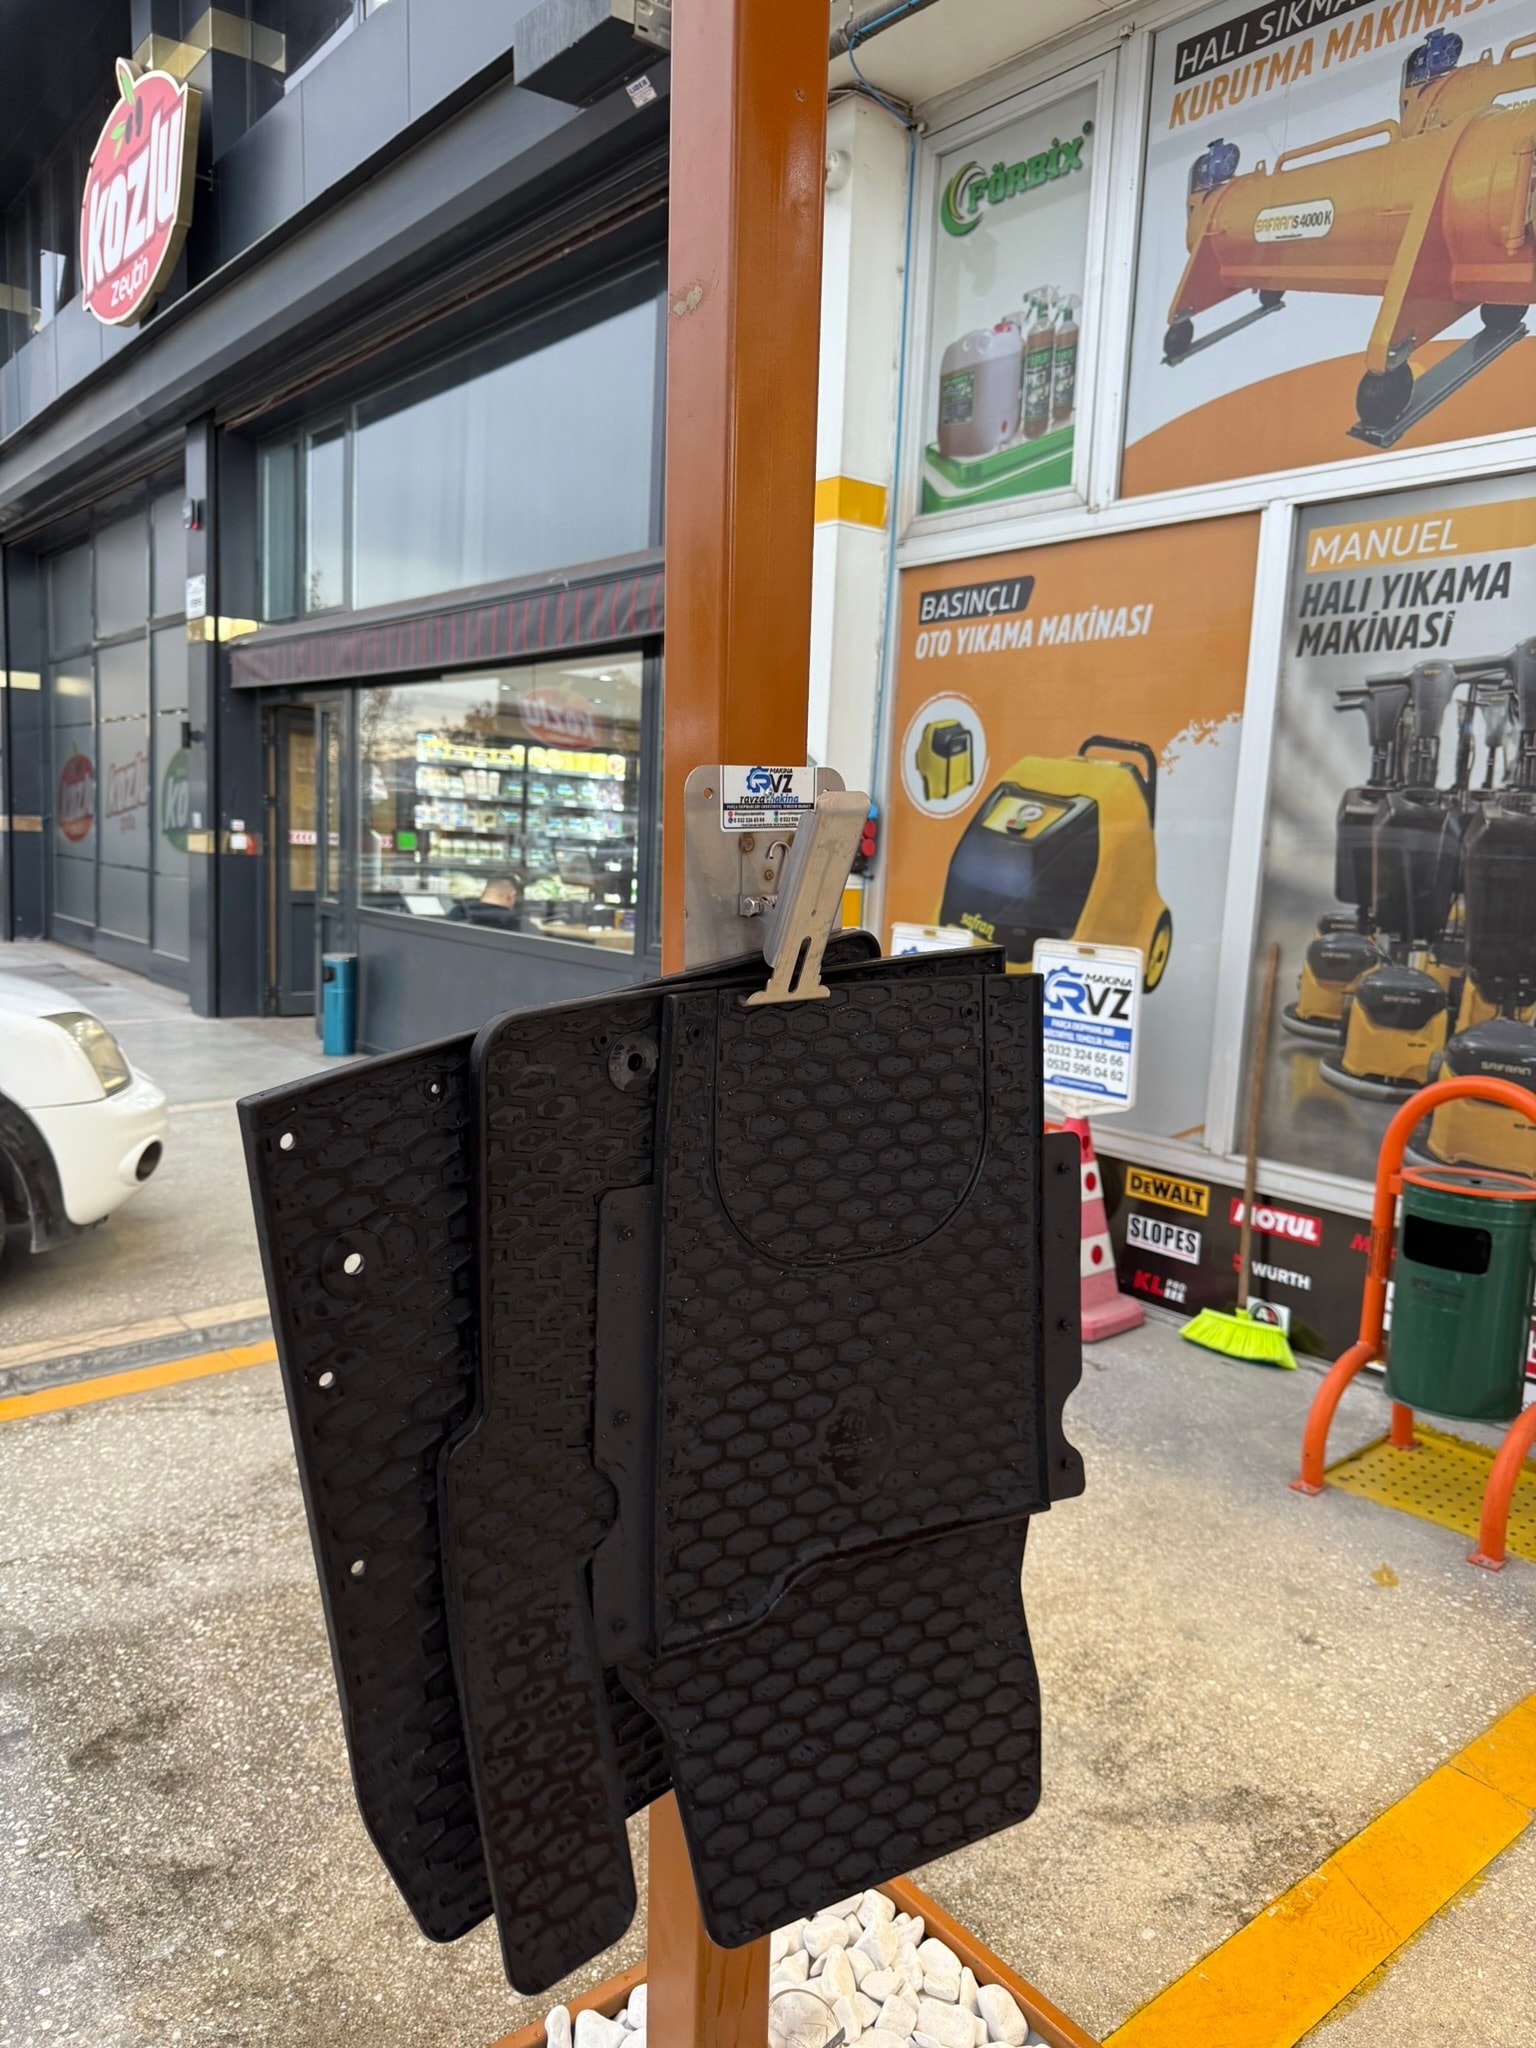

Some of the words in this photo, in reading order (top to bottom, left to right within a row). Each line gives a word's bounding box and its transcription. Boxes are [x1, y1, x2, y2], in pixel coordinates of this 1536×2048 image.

[1178, 22, 1248, 79] HALI
[1169, 37, 1314, 129] KURUTMA
[110, 255, 149, 307] zeytin
[1310, 519, 1458, 567] MANUEL
[920, 583, 1021, 621] BASINÇLI
[1299, 577, 1373, 618] HALI
[1381, 561, 1512, 611] YIKAMA
[915, 629, 951, 660] OTO
[957, 619, 1033, 656] YIKAMA
[1037, 603, 1154, 647] MAKİNASI
[1049, 978, 1133, 1020] RVZ
[1046, 1058, 1070, 1071] 0532
[1110, 1069, 1124, 1082] 62
[1047, 1043, 1071, 1057] 0332
[1074, 1048, 1092, 1060] 324
[1094, 1052, 1107, 1064] 65
[1110, 1054, 1124, 1067] 66
[1130, 1217, 1197, 1254] SLOPES
